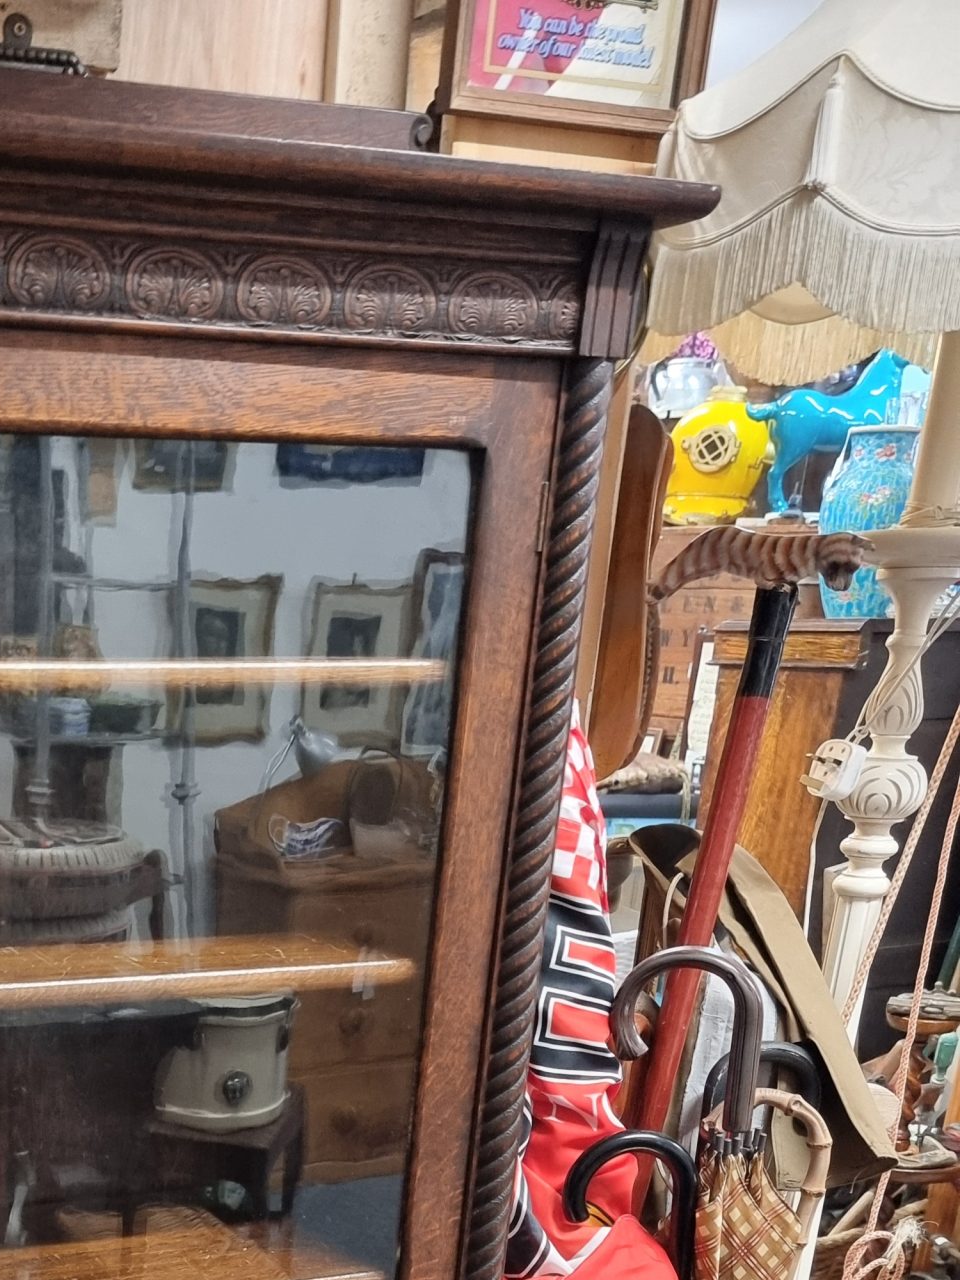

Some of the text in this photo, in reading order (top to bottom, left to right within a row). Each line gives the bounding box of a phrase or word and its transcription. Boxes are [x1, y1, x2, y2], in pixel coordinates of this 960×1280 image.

[518, 8, 646, 46] You can be the proud
[497, 33, 539, 53] owner
[538, 35, 559, 59] of
[552, 42, 577, 58] our
